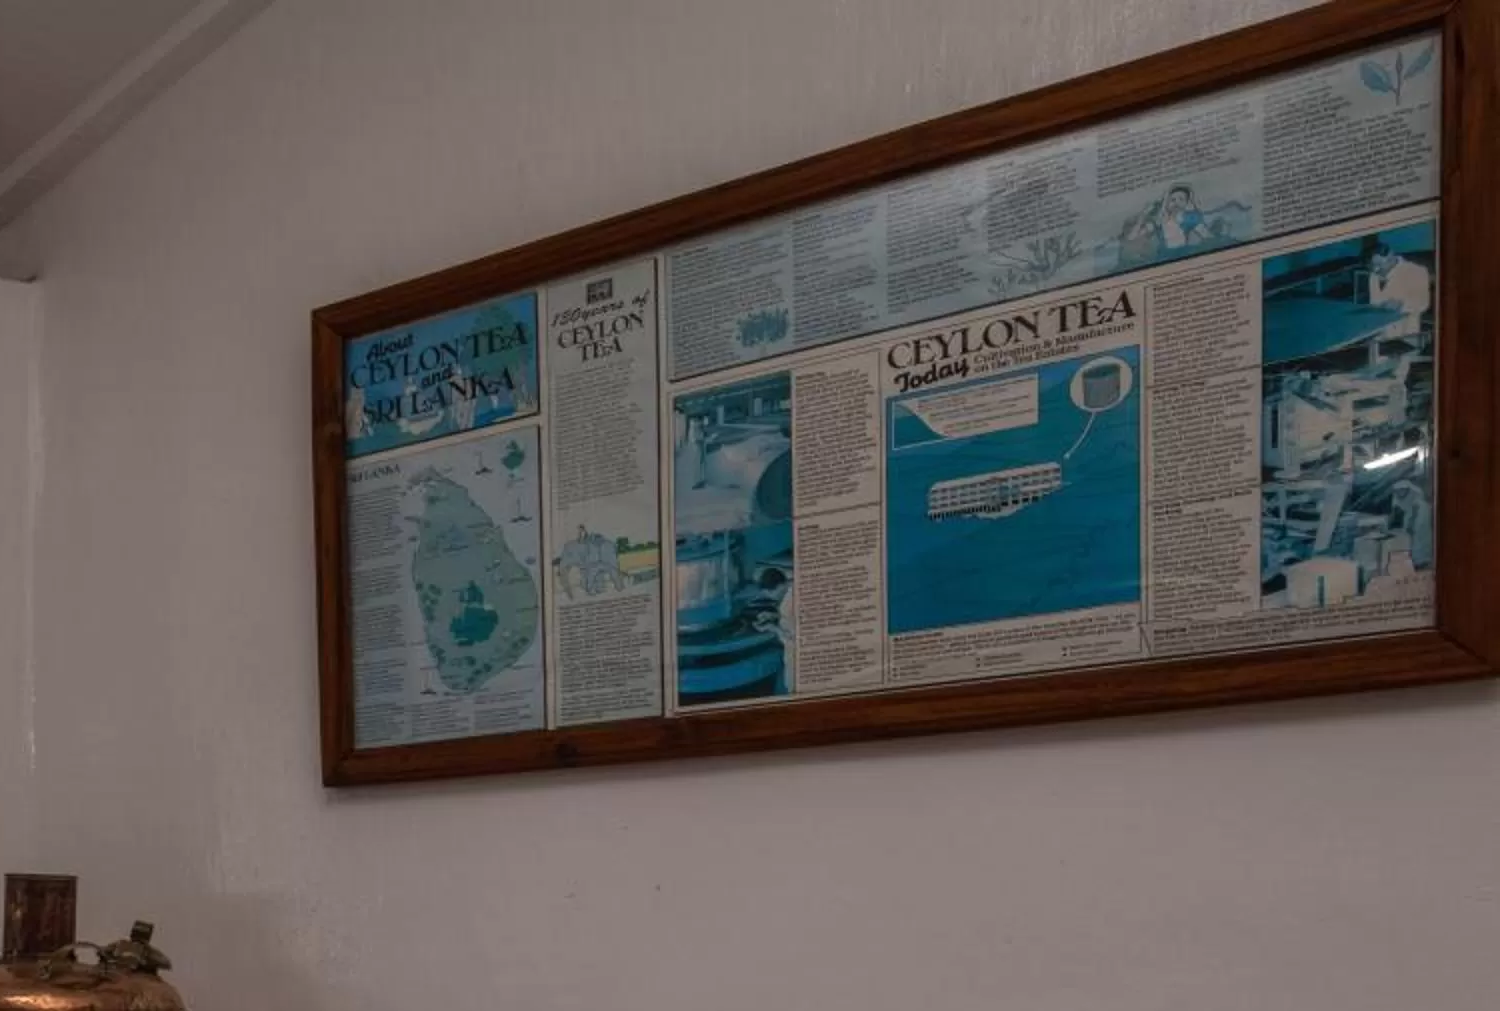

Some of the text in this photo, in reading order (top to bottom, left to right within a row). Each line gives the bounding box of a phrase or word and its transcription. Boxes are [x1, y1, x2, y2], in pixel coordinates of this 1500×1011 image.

[366, 333, 416, 363] About
[558, 310, 645, 350] CEYLON
[887, 312, 1040, 370] CEYLON
[1049, 290, 1137, 333] TEA
[350, 321, 529, 390] CEYLON TEA
[577, 336, 623, 363] TEA
[421, 362, 453, 388] and
[894, 356, 971, 393] Today
[361, 367, 517, 426] SRI LANKA
